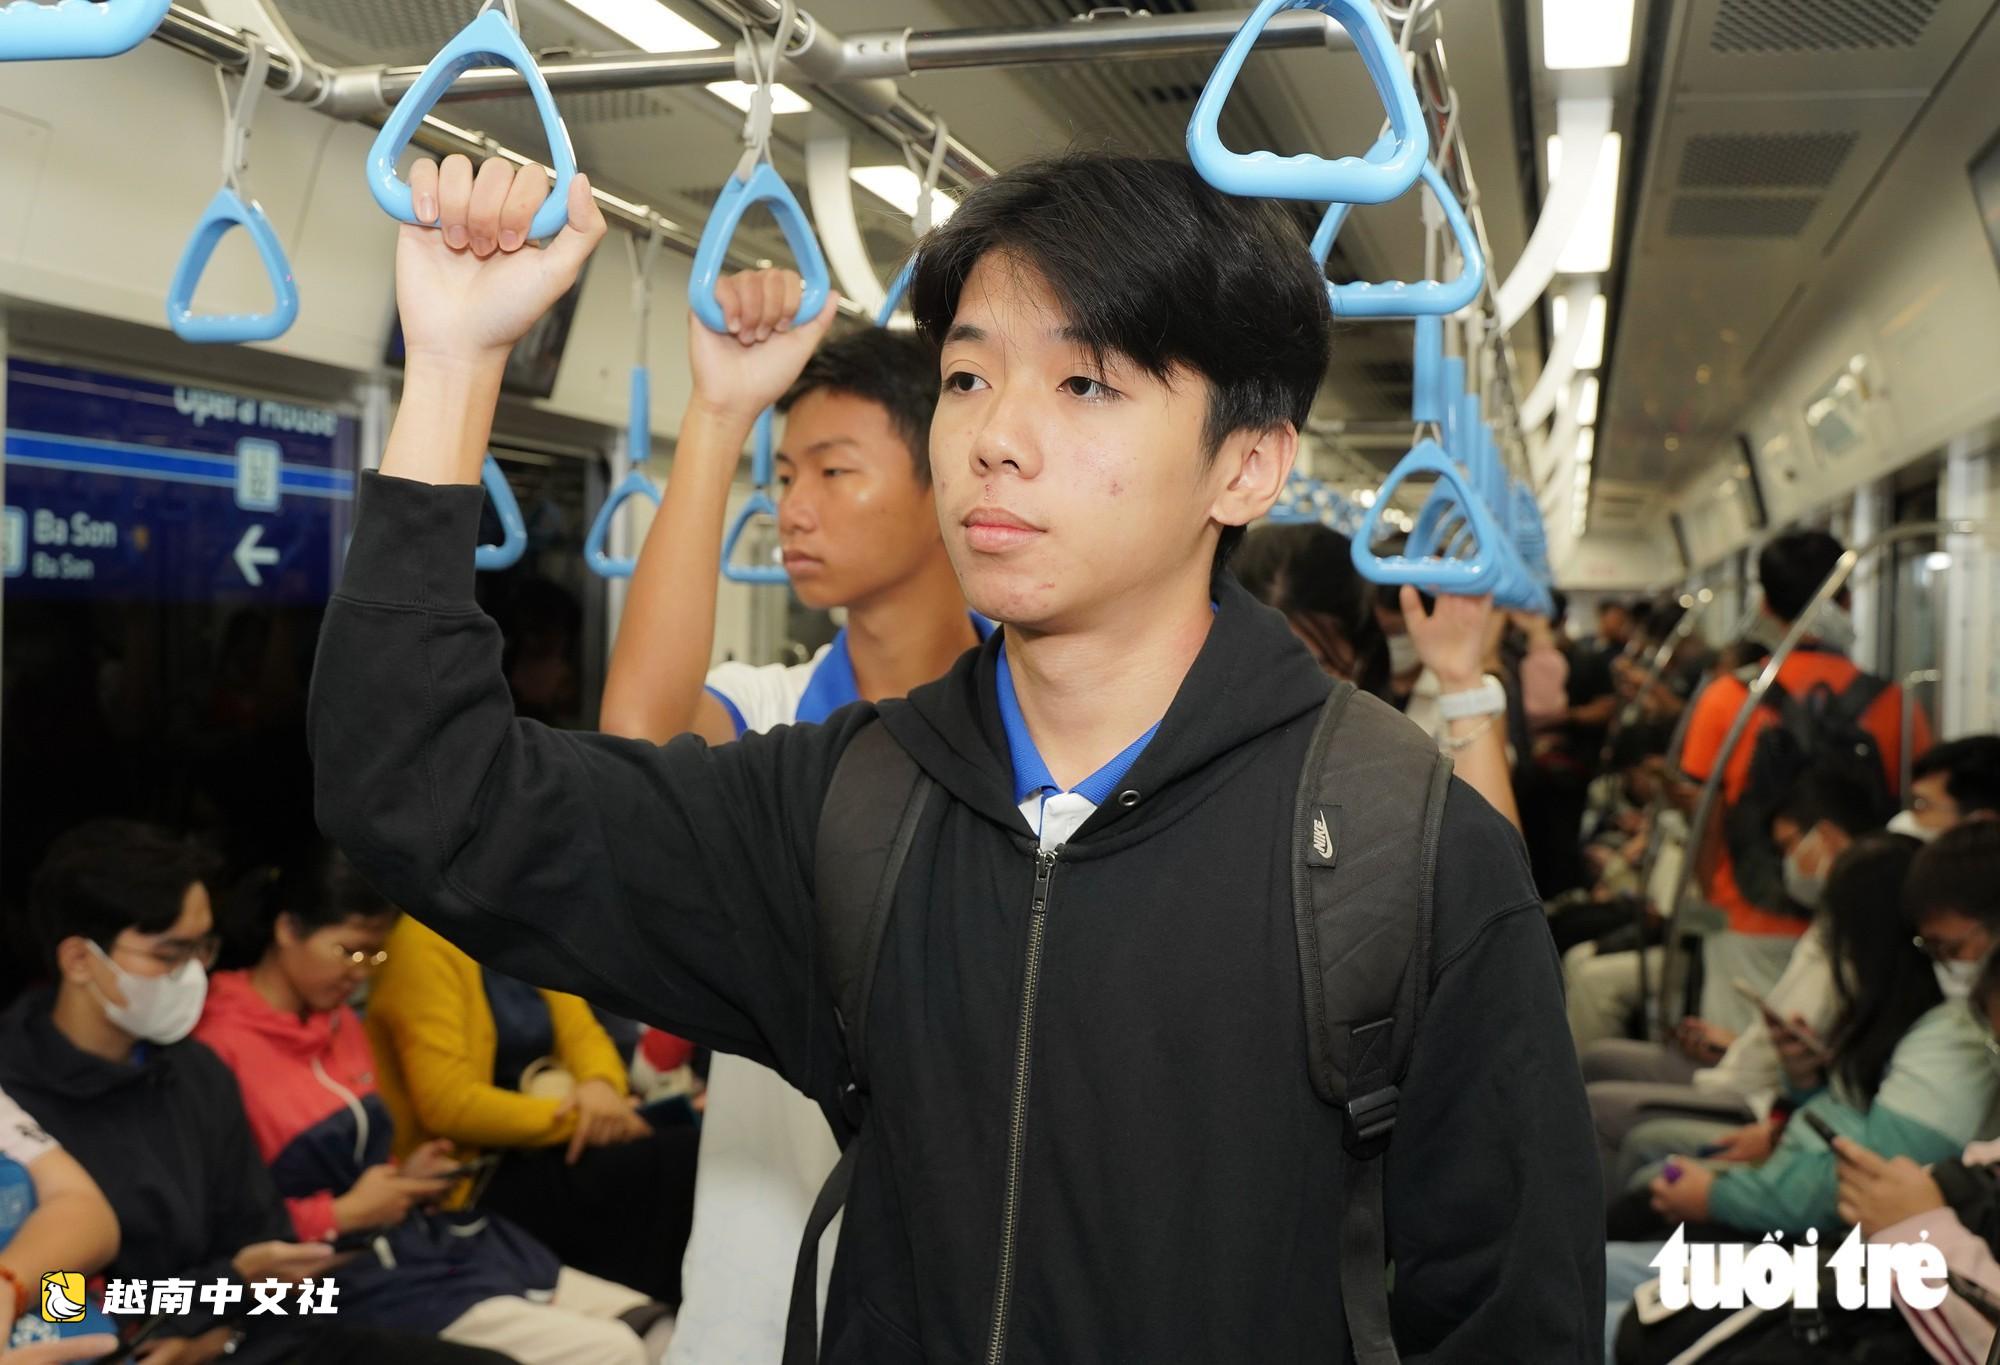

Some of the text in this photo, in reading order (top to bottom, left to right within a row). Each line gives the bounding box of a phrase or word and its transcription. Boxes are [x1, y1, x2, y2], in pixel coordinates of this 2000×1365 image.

[33, 508, 118, 548] Ba Son
[32, 551, 59, 579] Ba
[1313, 819, 1327, 853] NIKE
